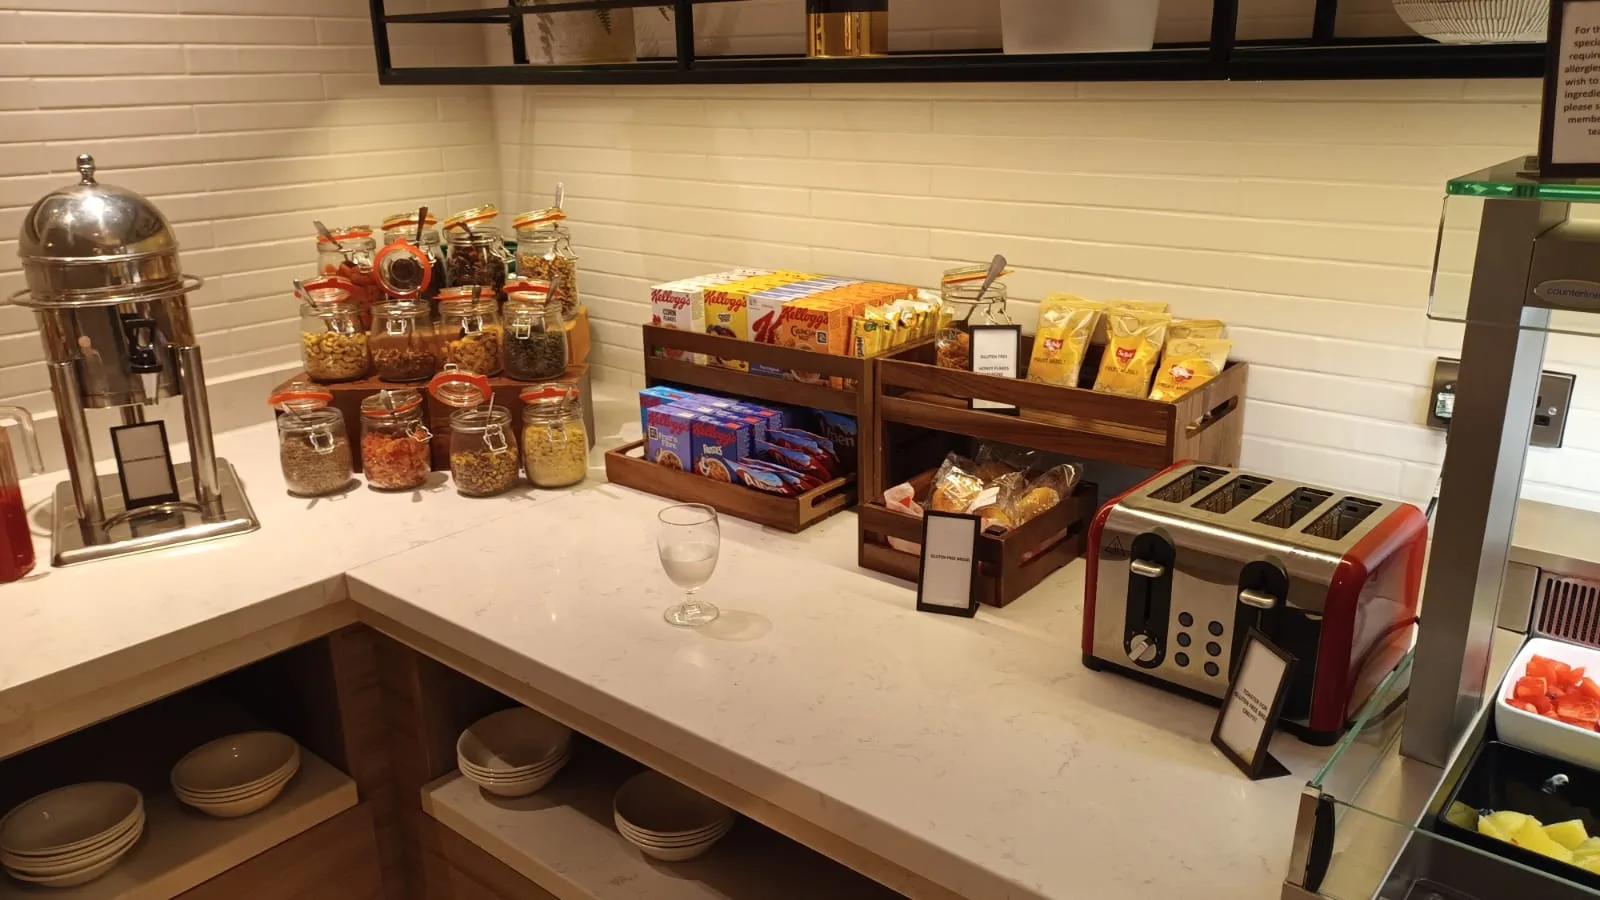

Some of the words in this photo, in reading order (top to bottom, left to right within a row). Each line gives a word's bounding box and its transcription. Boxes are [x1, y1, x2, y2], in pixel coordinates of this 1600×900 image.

[1575, 26, 1591, 35] For
[1565, 77, 1586, 86] wish
[1563, 103, 1593, 112] please
[651, 289, 691, 310] Kellogg's
[703, 290, 747, 312] Kellogg's
[782, 306, 828, 329] Kellogg's
